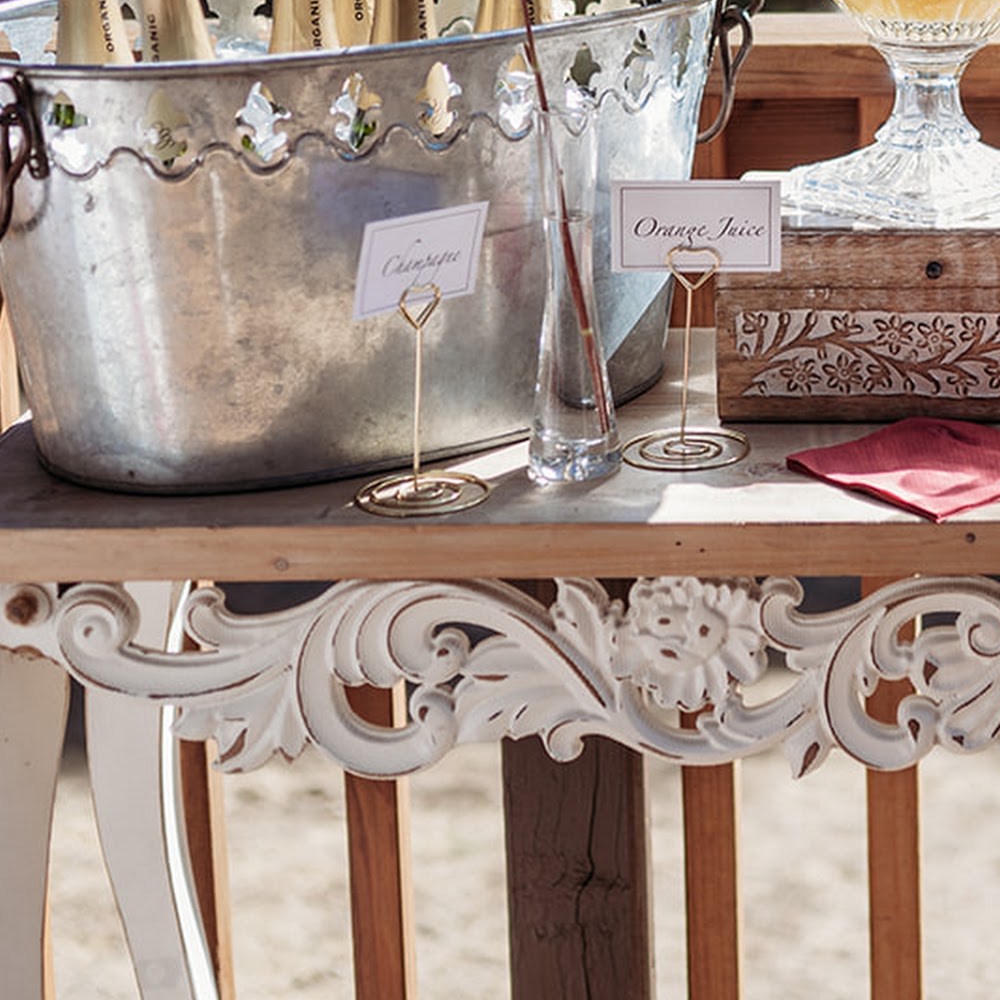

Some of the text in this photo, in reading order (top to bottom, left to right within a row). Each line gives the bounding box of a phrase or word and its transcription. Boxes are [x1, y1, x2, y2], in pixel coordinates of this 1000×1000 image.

[147, 13, 160, 63] GANIC
[634, 216, 766, 248] Orange Juice
